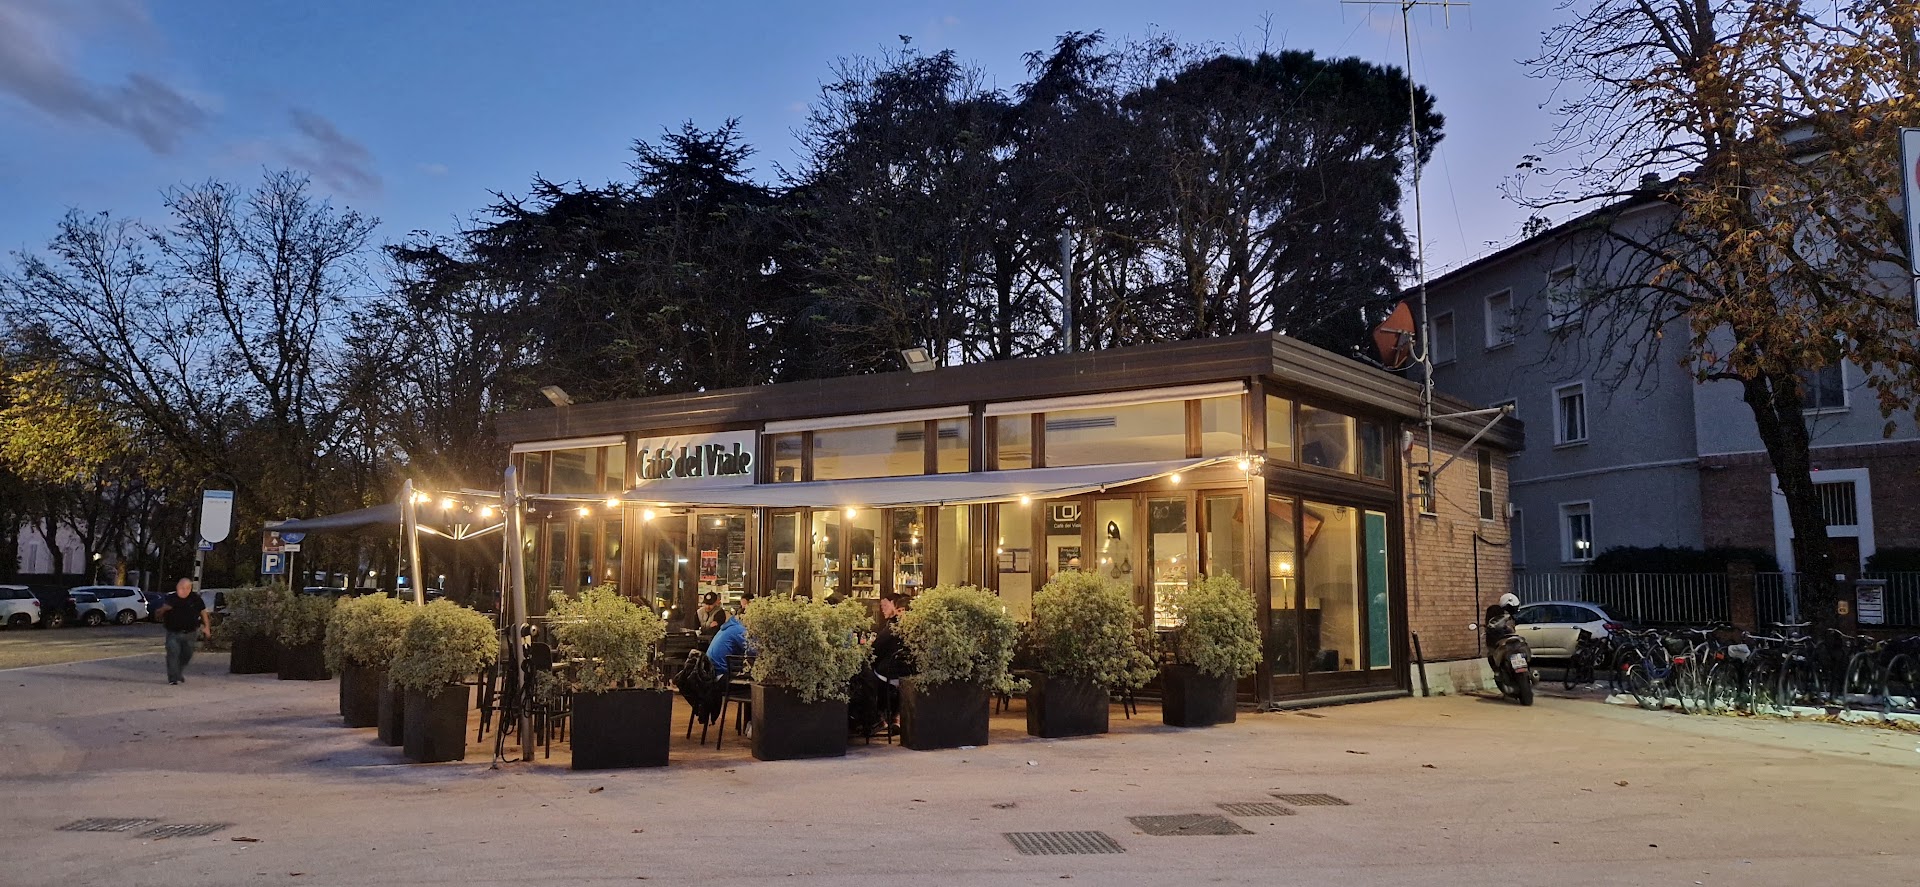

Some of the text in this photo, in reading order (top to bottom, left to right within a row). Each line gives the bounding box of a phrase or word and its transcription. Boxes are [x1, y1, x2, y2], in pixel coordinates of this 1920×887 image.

[675, 446, 703, 477] del
[705, 443, 752, 476] Viale
[266, 554, 278, 572] P
